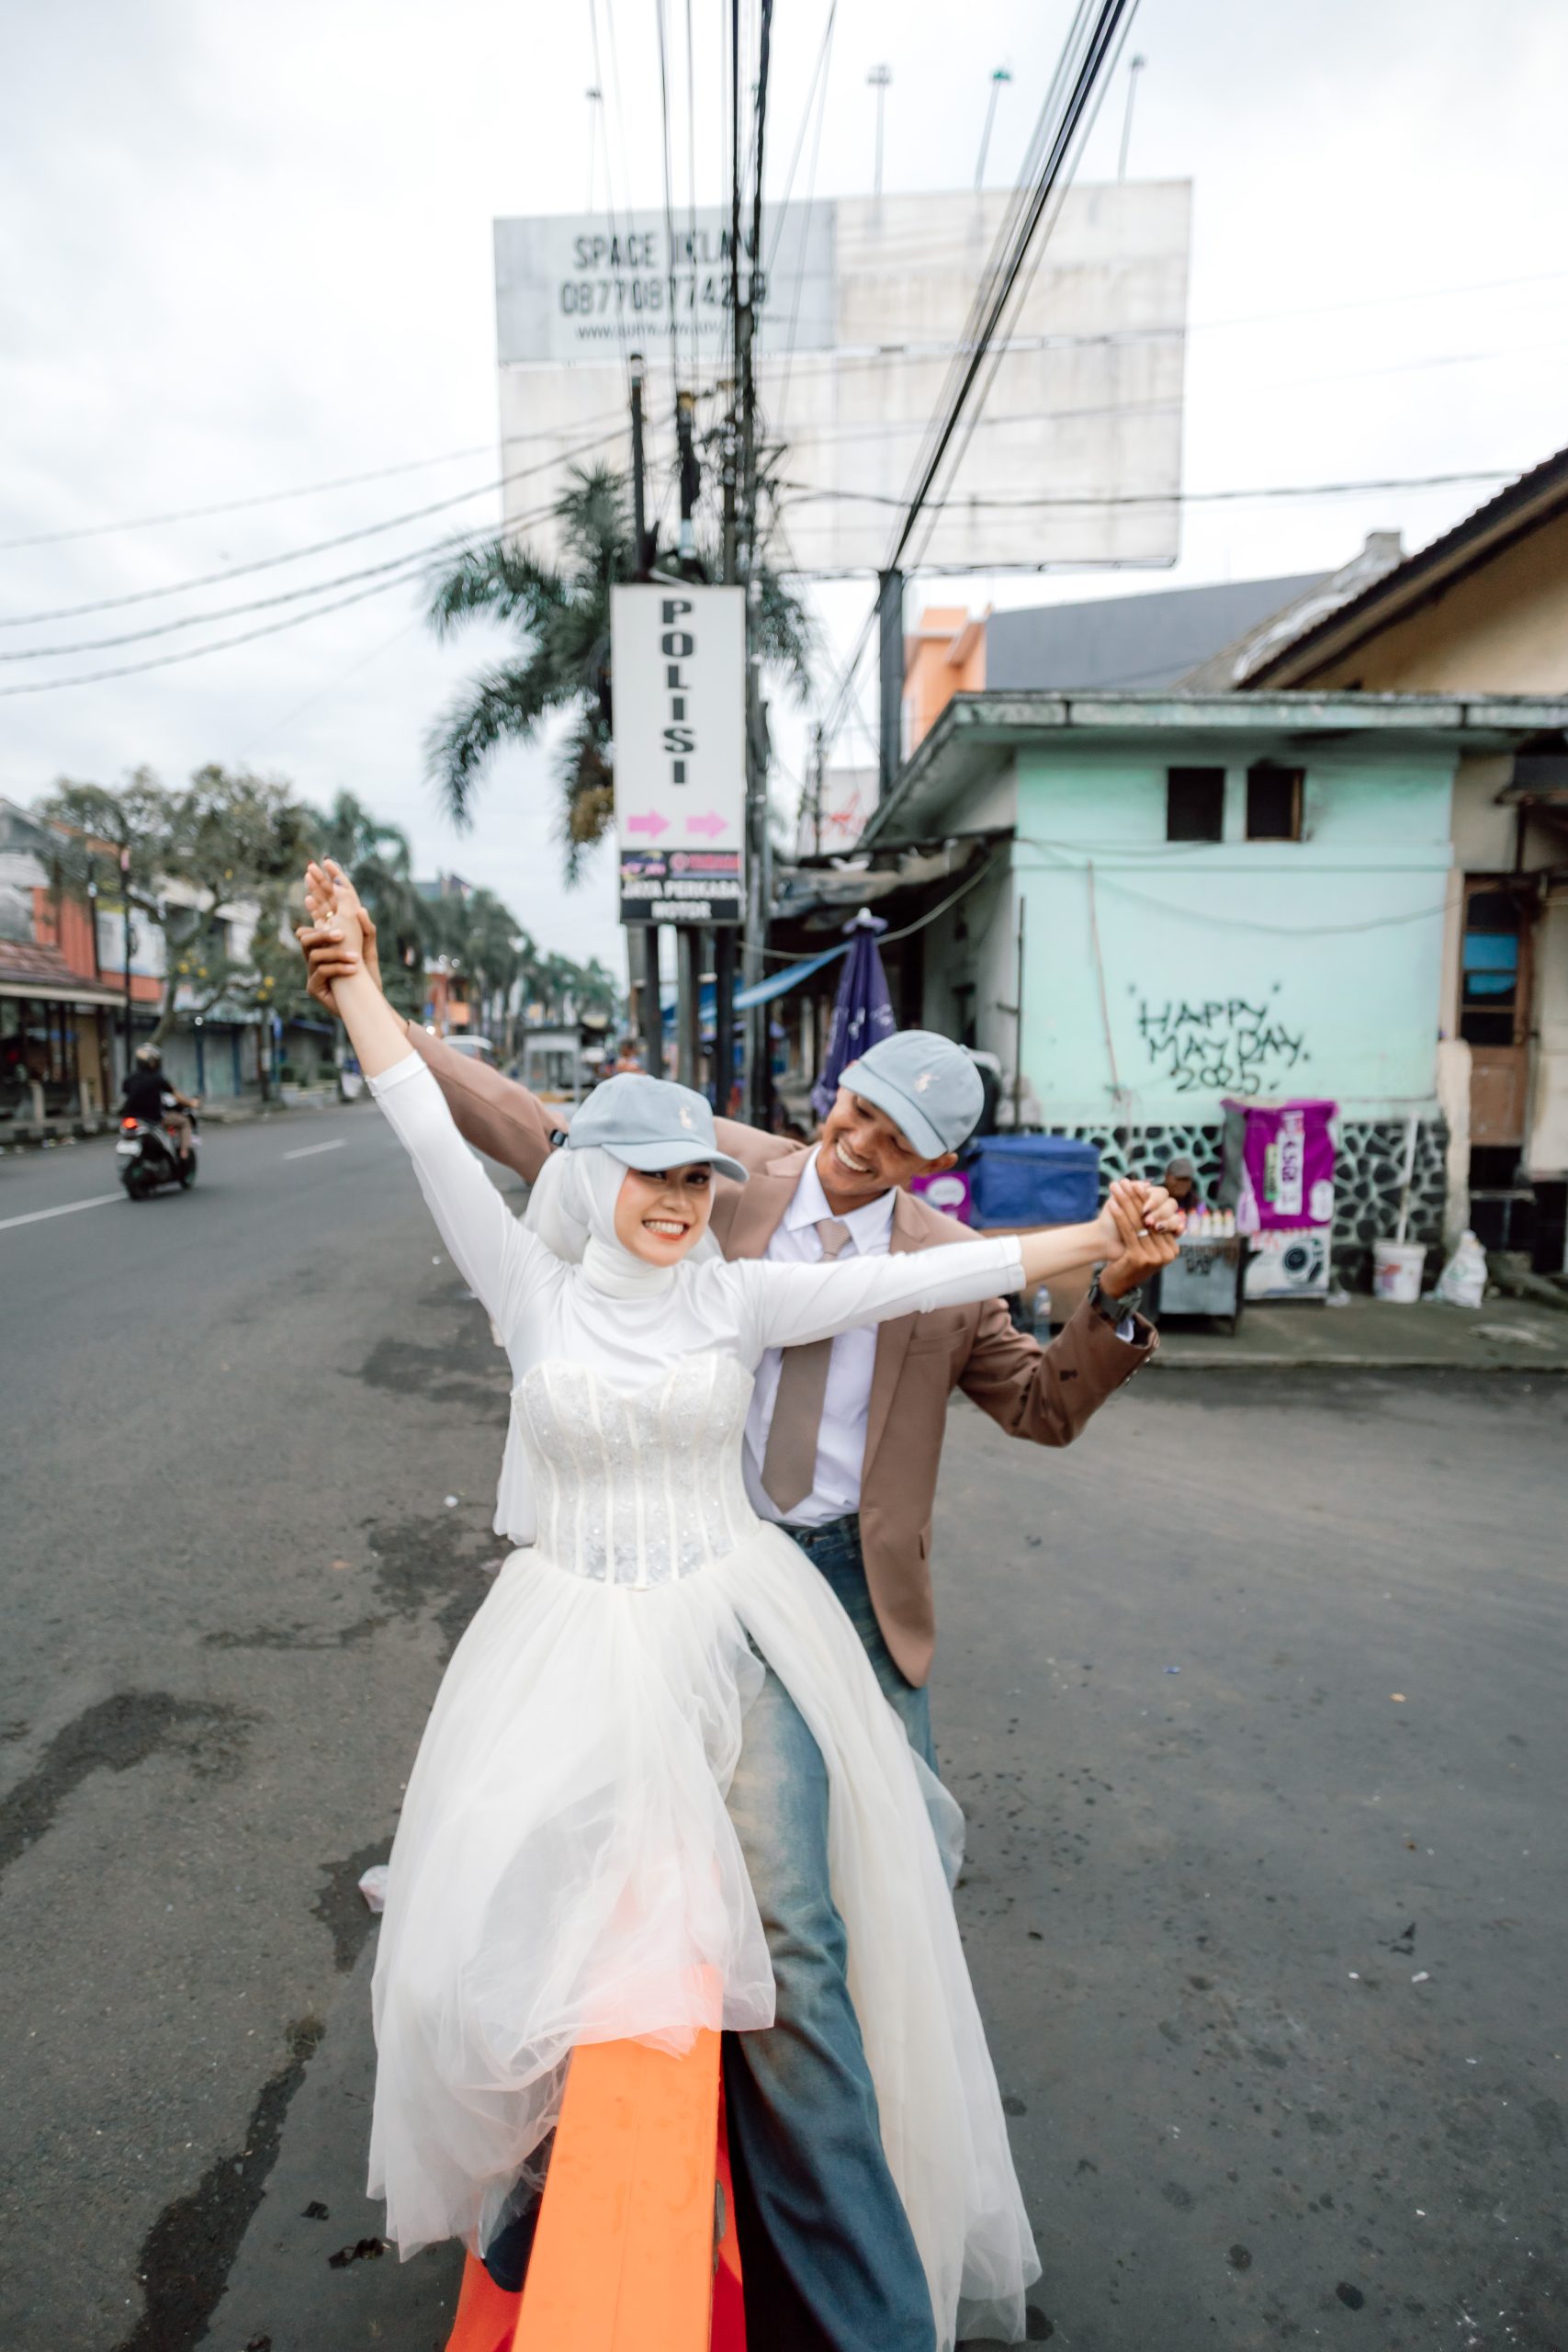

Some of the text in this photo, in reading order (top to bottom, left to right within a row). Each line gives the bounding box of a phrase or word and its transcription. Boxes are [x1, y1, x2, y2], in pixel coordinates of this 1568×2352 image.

[572, 233, 660, 269] SPACE
[660, 599, 695, 784] POLISI
[1139, 997, 1269, 1037] HAPPY
[1149, 1034, 1229, 1071] MAY
